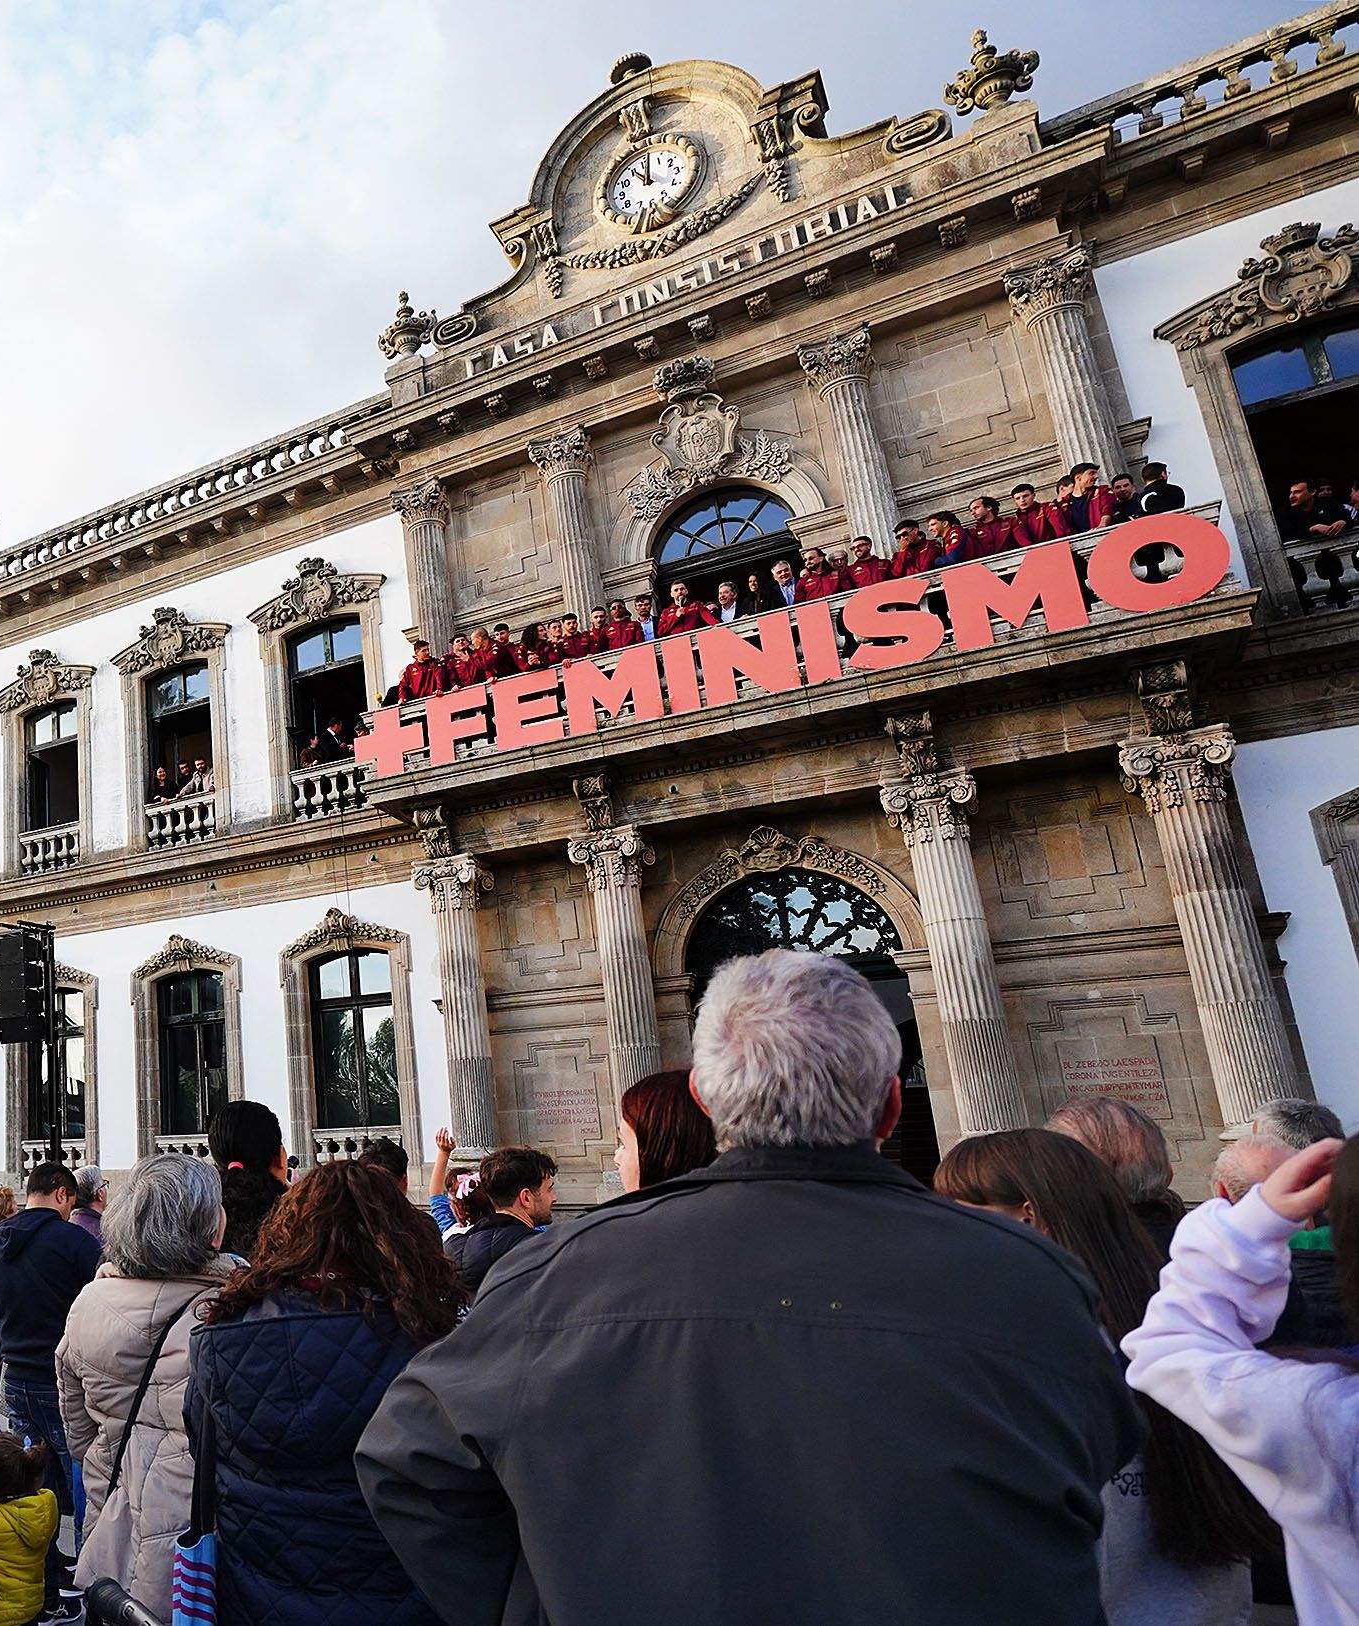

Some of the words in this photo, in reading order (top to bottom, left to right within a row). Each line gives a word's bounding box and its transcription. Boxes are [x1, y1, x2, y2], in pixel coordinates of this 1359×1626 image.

[667, 158, 674, 167] 2
[673, 166, 680, 175] 3
[621, 178, 630, 188] 10
[619, 191, 626, 200] 9
[624, 200, 631, 208] 8
[465, 323, 560, 378] CASA
[593, 185, 915, 326] CONSISTORIAL
